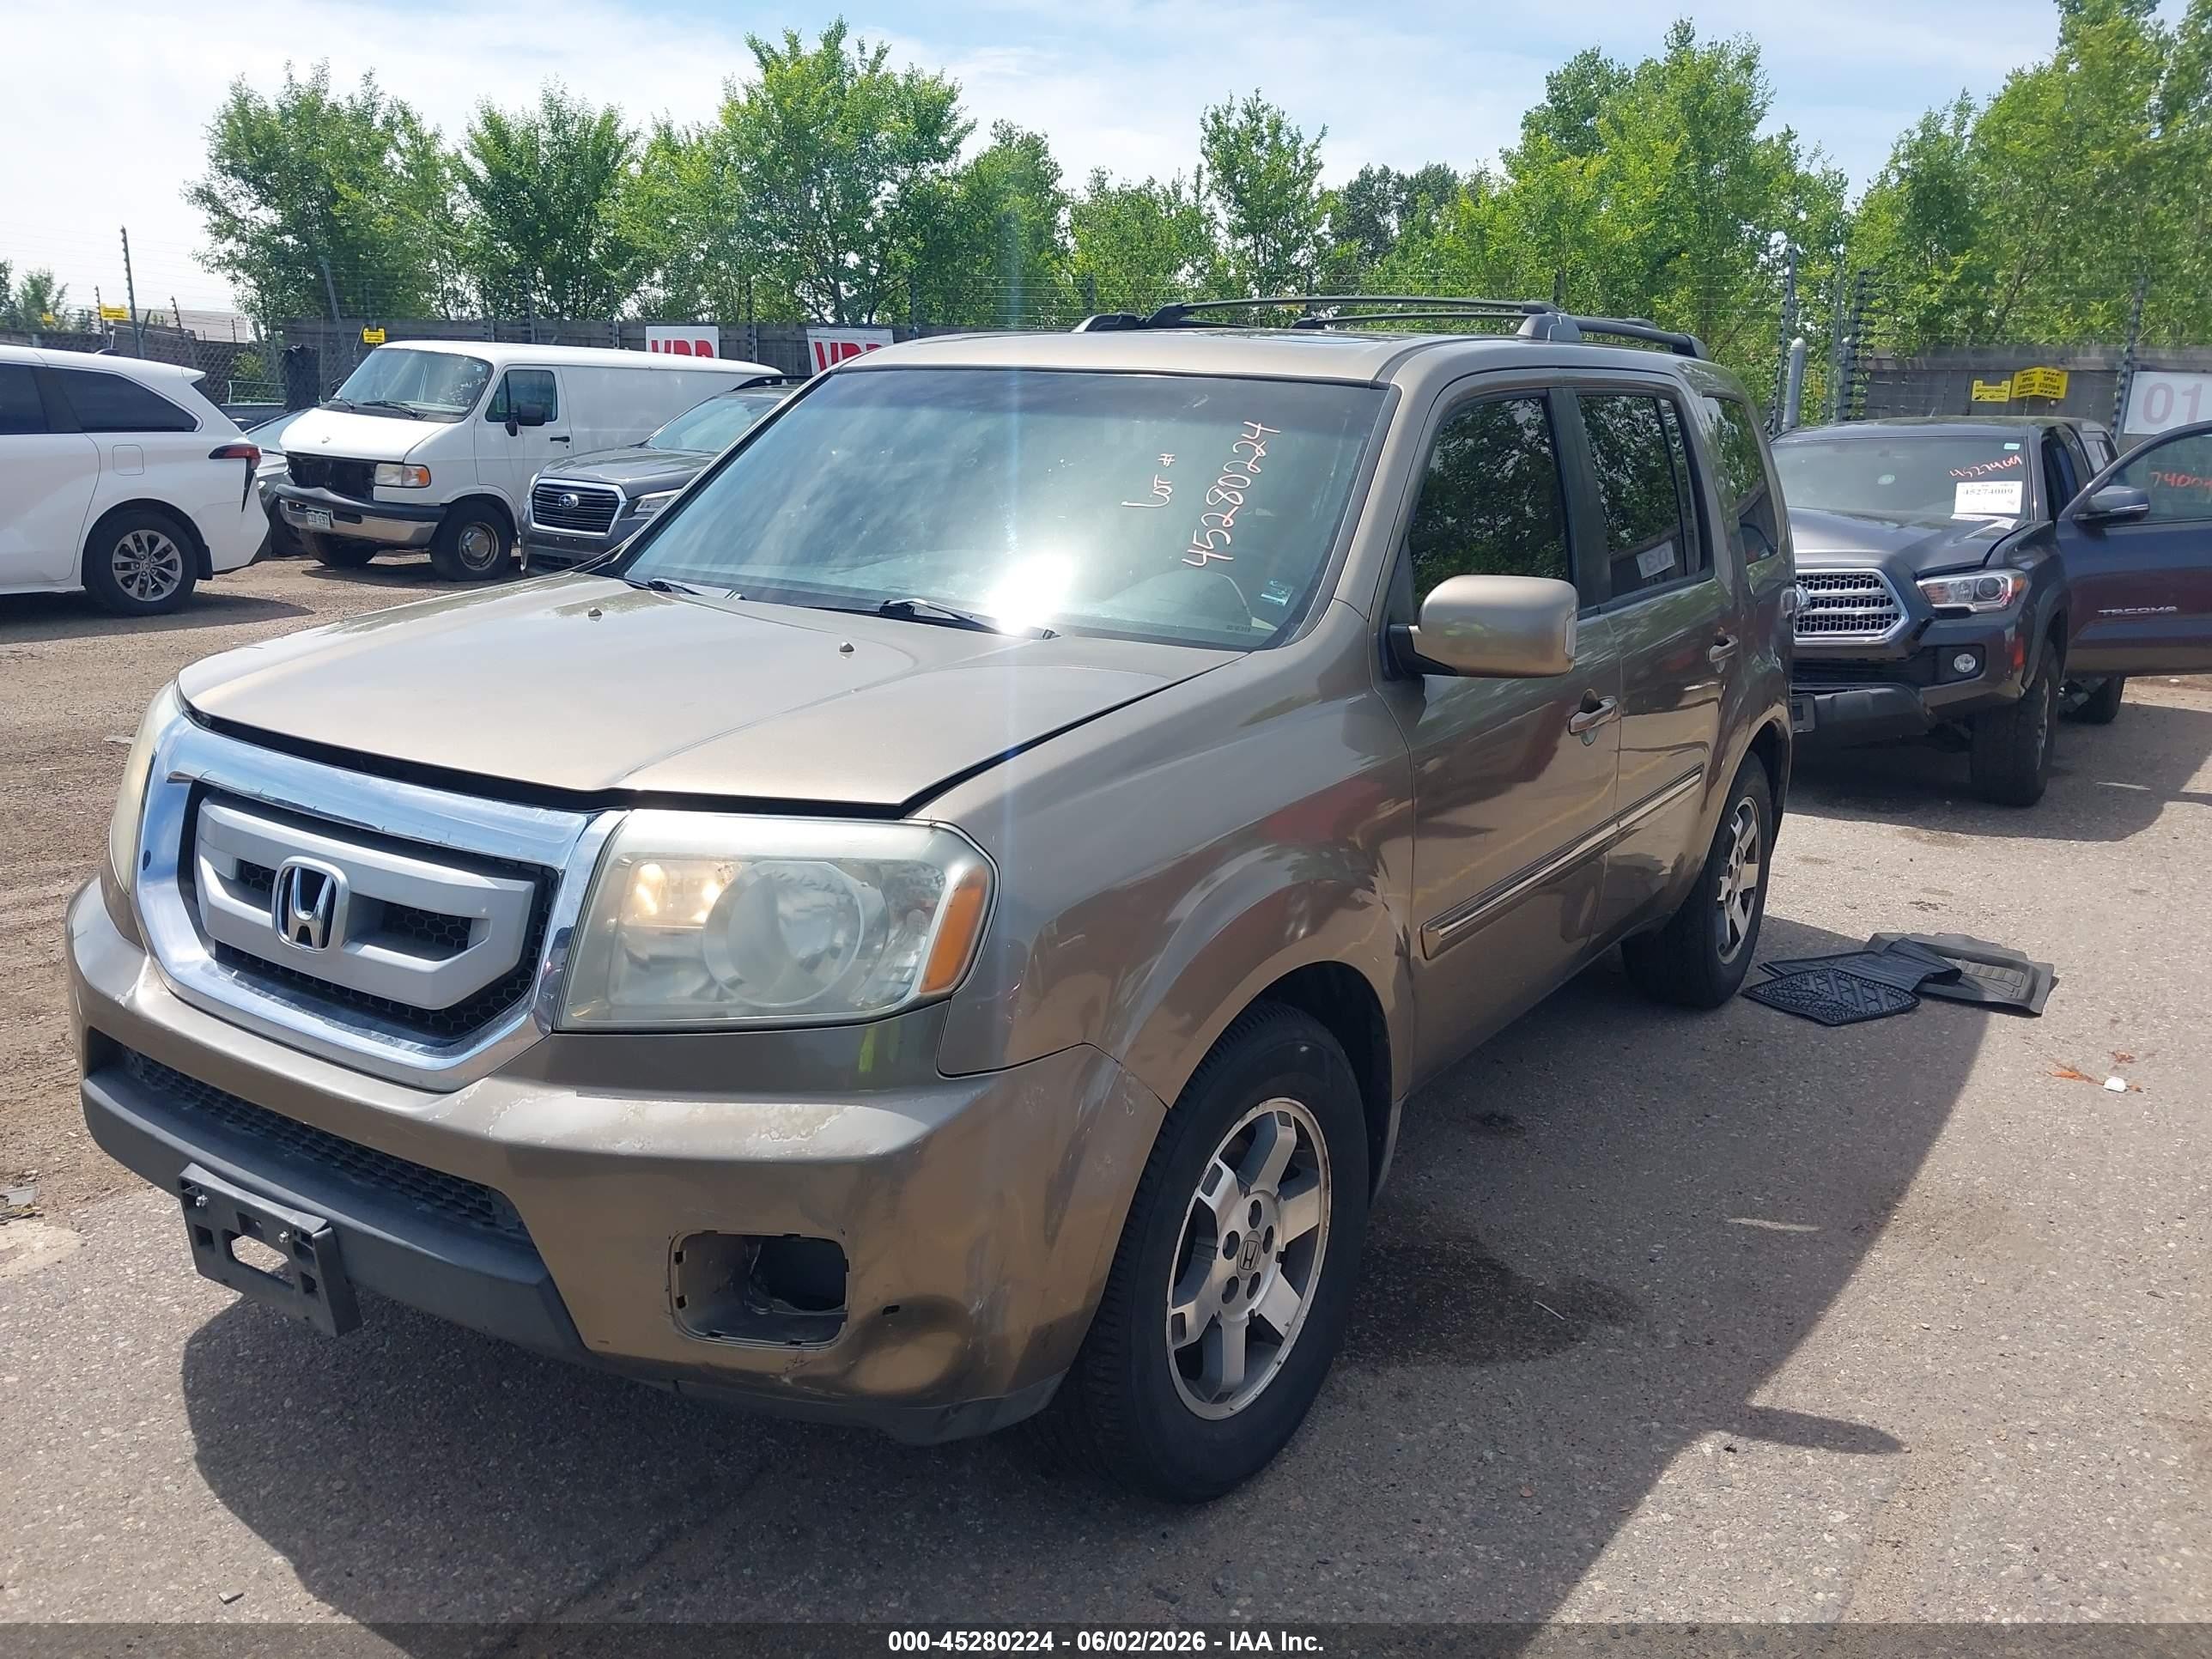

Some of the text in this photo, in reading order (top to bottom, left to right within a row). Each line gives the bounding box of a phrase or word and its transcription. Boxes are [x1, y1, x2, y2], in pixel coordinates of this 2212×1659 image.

[2143, 383, 2203, 424] 01
[1158, 453, 1176, 467] #
[1181, 421, 1281, 568] 45280224
[2097, 605, 2179, 616] TACOMA
